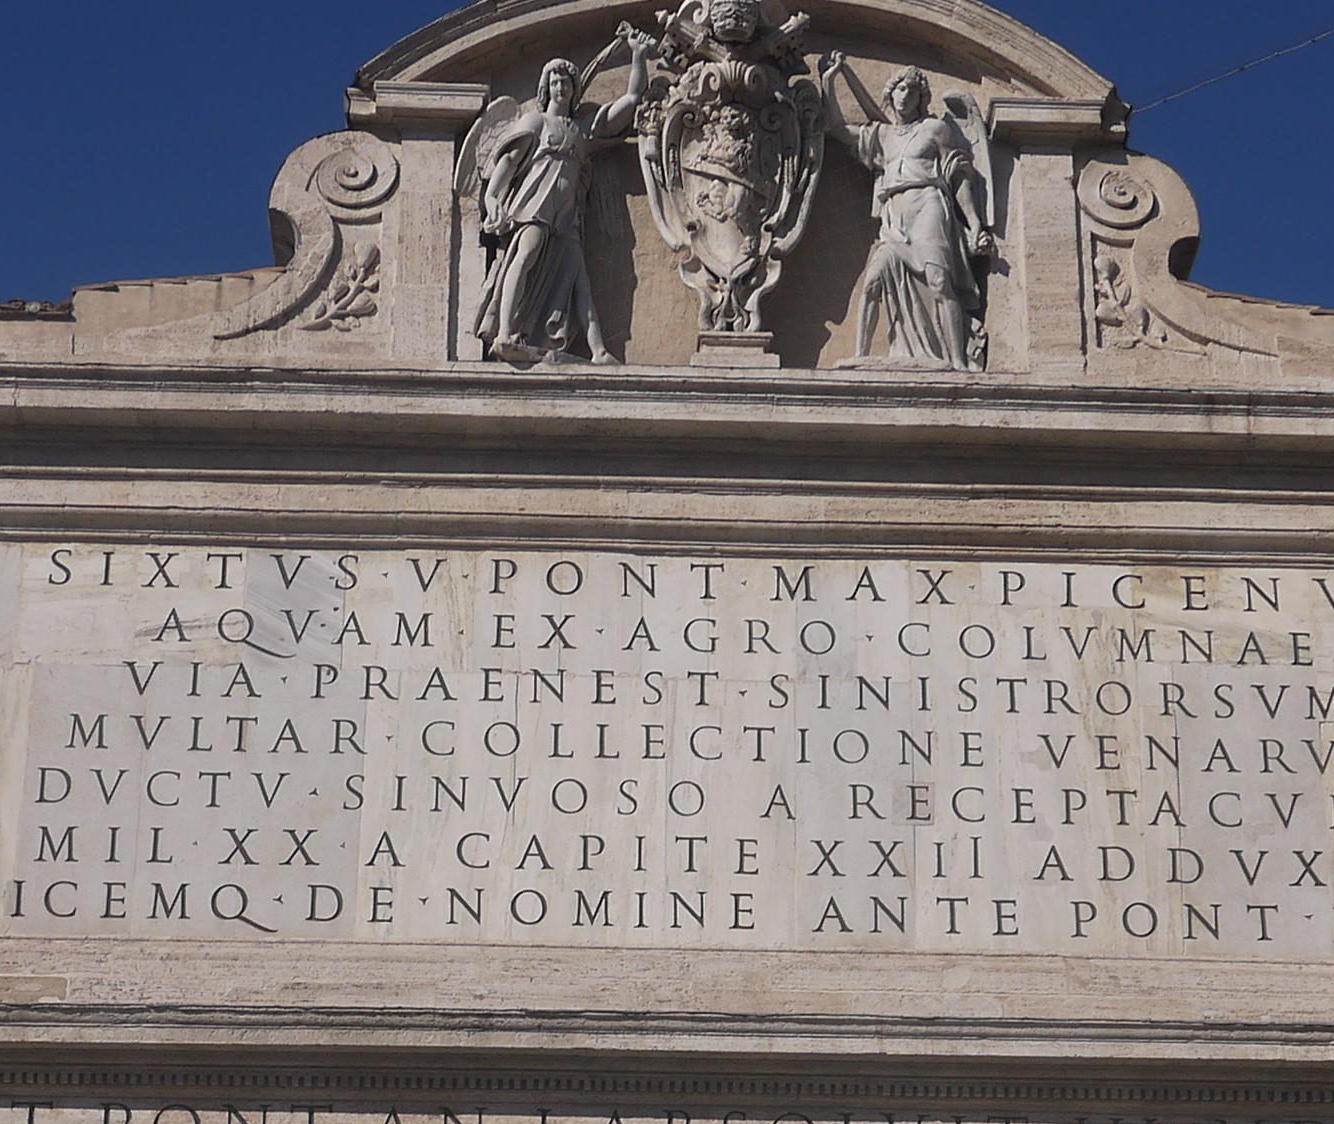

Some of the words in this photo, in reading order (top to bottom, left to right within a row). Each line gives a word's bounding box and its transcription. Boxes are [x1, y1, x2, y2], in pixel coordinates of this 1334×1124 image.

[48, 549, 358, 591] SIXTVS
[406, 558, 447, 592] V
[489, 559, 724, 599] PONT
[770, 566, 954, 605] MAX
[152, 608, 433, 658] AQVAM
[491, 615, 576, 649] EX
[622, 616, 836, 655] AGRO
[898, 623, 1313, 666] COLVMNAE
[123, 661, 261, 698] VIA
[311, 664, 719, 706] PRAENEST
[65, 714, 367, 754] MVLTAR
[422, 721, 984, 767] COLLECTIONE
[35, 767, 290, 808] DVCTV
[343, 775, 704, 817] SINVOSO
[760, 784, 796, 820] A
[34, 826, 172, 863] MIL
[218, 828, 319, 866] XX
[365, 831, 405, 867] A
[456, 832, 759, 875] CAPITE
[807, 837, 982, 878] XXII
[305, 885, 393, 923] DE
[446, 888, 754, 929] NOMINE
[812, 896, 1018, 936] ANTE
[1071, 901, 1278, 941] PONT
